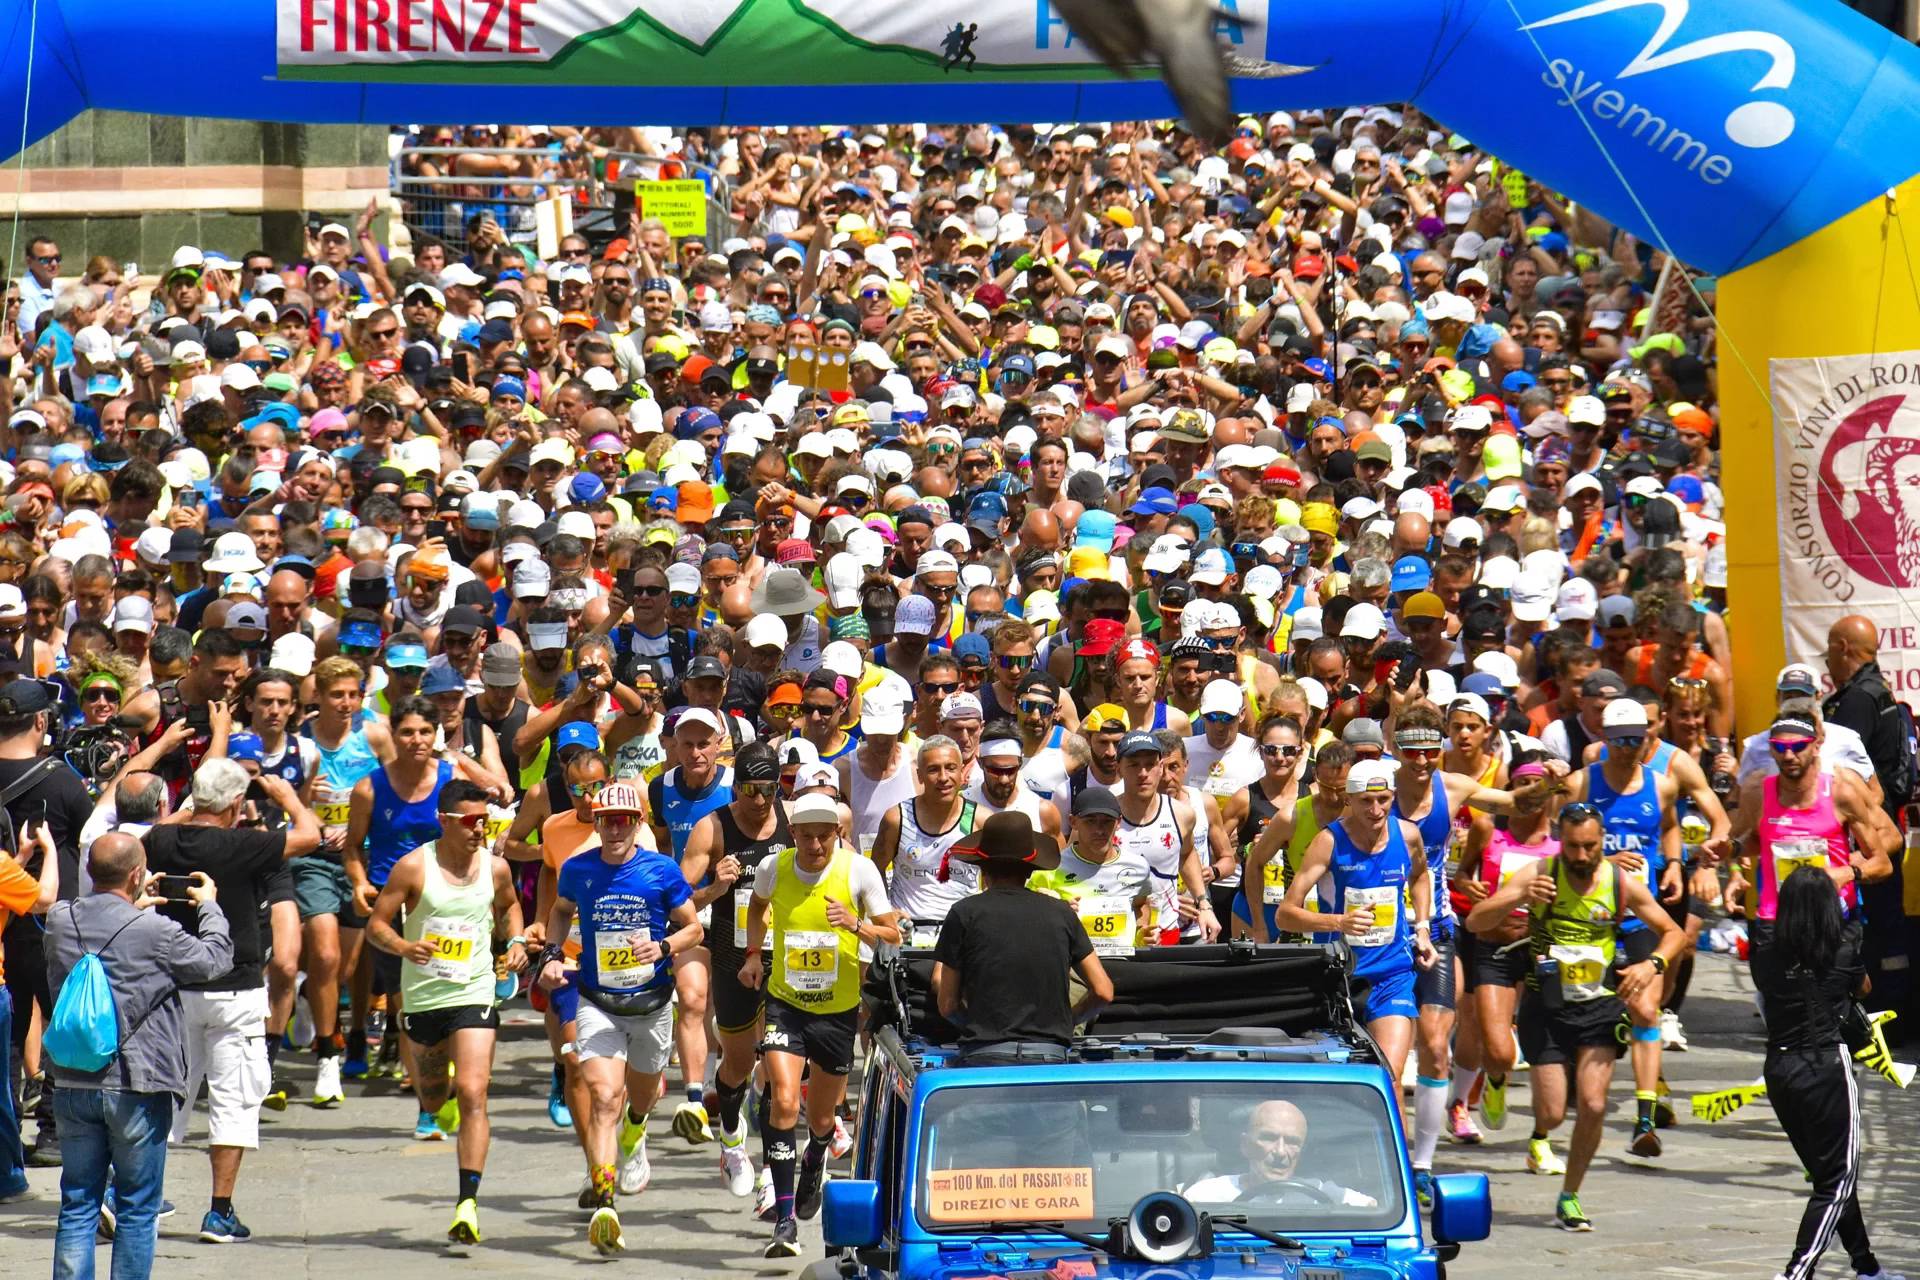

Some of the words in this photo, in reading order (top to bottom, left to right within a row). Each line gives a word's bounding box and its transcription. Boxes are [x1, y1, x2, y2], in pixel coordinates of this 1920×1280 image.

[300, 0, 541, 53] FIRENZE
[1541, 58, 1733, 185] syemme
[1834, 373, 1866, 405] DI
[1794, 395, 1837, 450] VINI
[1789, 462, 1855, 602] CONSORZIO
[1127, 735, 1153, 745] HOKA
[616, 746, 659, 761] HOKA
[599, 787, 636, 808] YEAH
[1339, 863, 1367, 871] macron
[1094, 917, 1114, 932] 85
[800, 951, 821, 967] 13
[431, 963, 455, 972] CRAFT
[1567, 965, 1589, 980] 81
[614, 974, 637, 982] CRAFT
[767, 1149, 795, 1161] HOKA
[953, 1175, 973, 1190] 100
[976, 1174, 996, 1189] Km.
[999, 1173, 1017, 1188] del
[943, 1198, 1029, 1211] DIREZIONE
[1035, 1197, 1080, 1209] GARA
